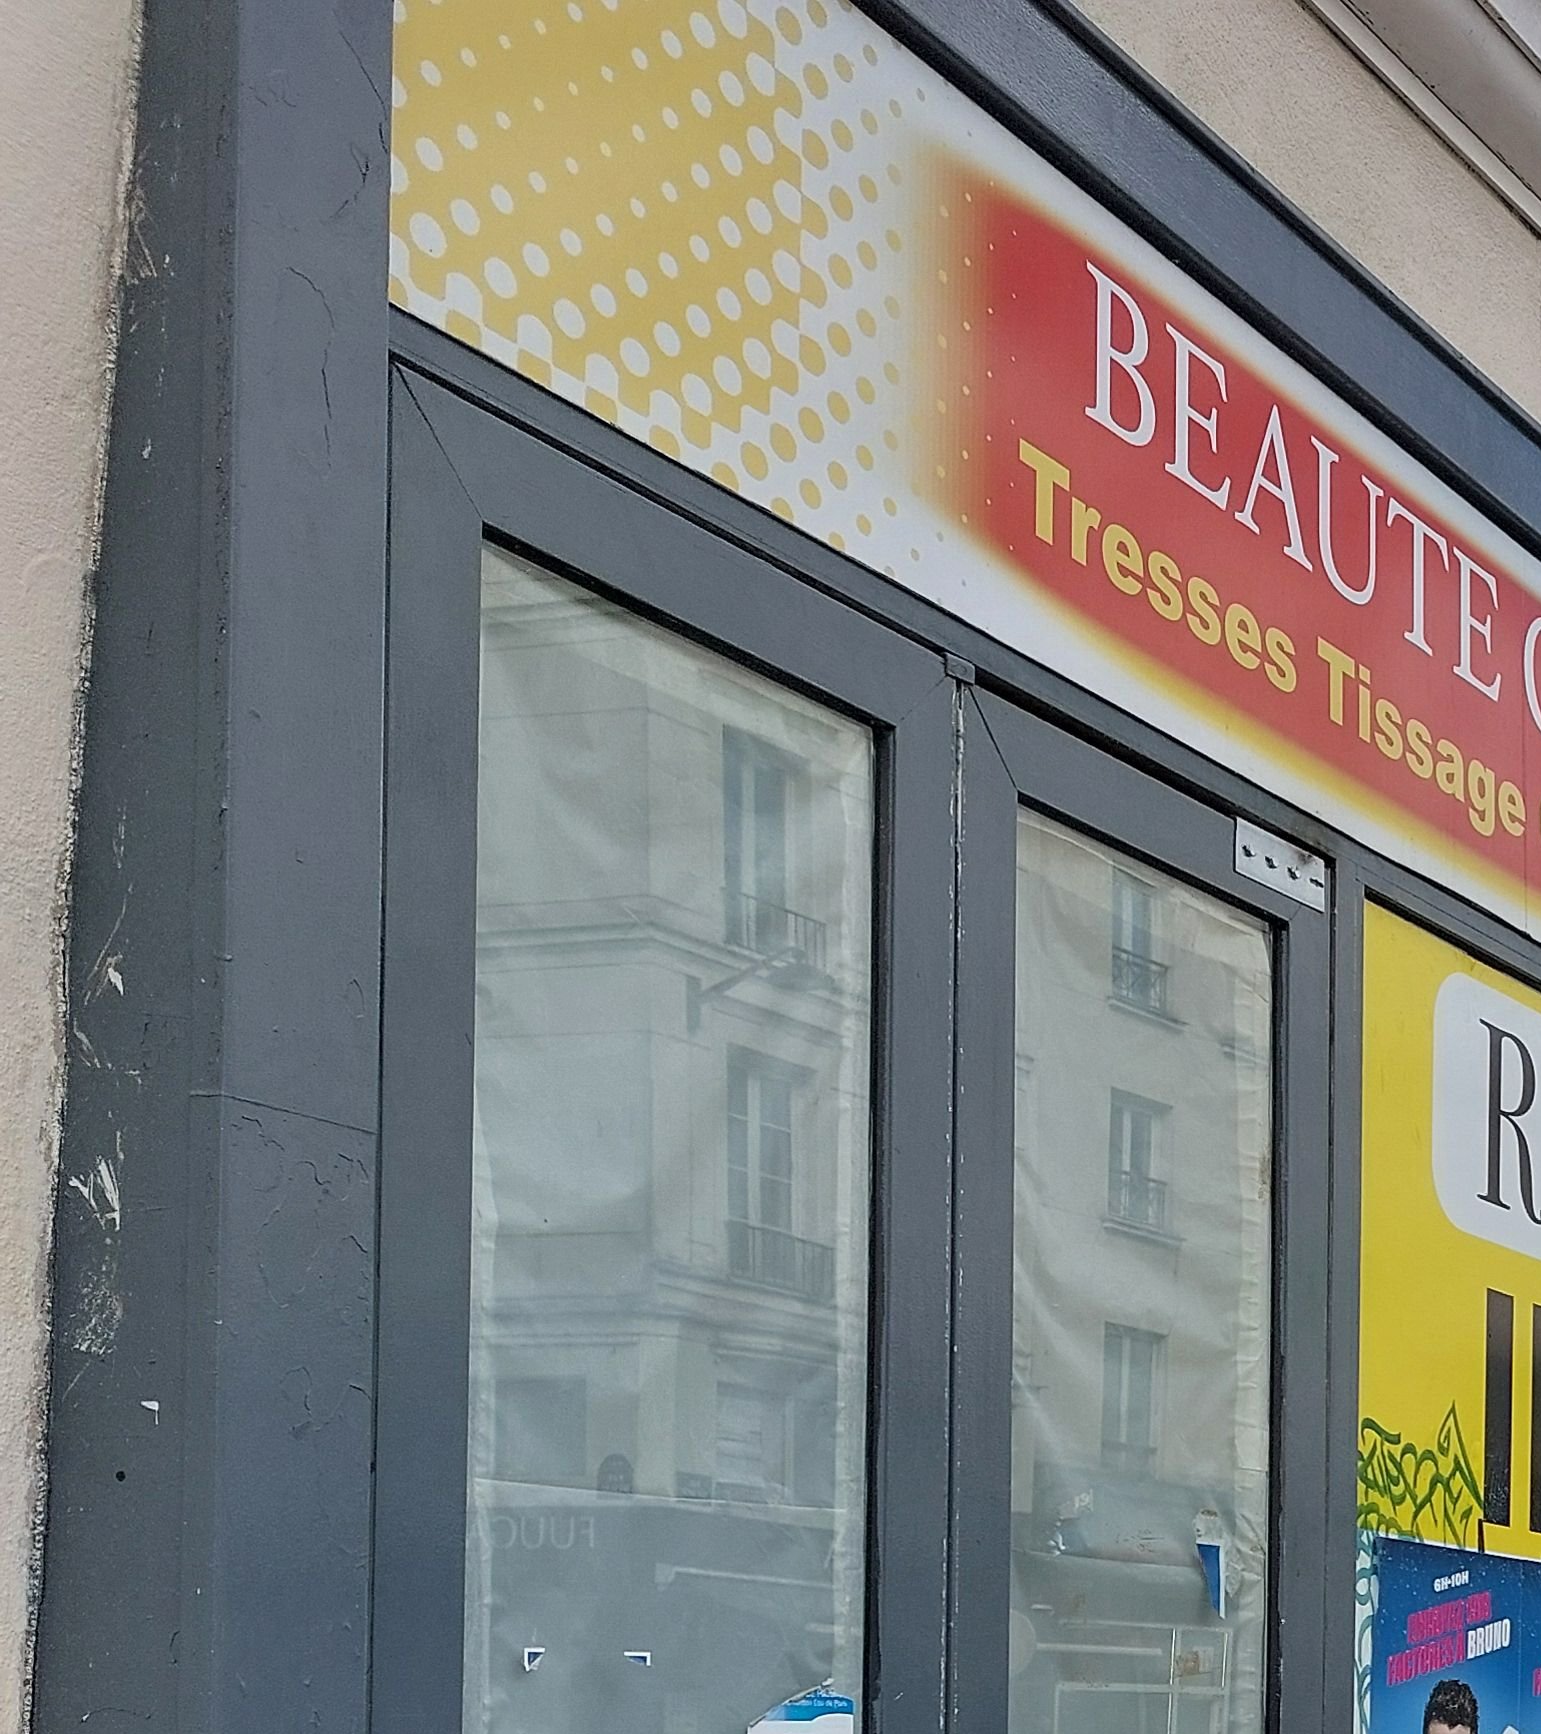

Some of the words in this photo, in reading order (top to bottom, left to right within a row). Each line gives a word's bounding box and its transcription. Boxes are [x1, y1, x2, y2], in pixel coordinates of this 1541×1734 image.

[1018, 439, 1298, 695] Tresses
[1316, 640, 1526, 840] Tissage
[1084, 260, 1502, 701] BEAUTE
[1467, 1618, 1511, 1660] BRUNO
